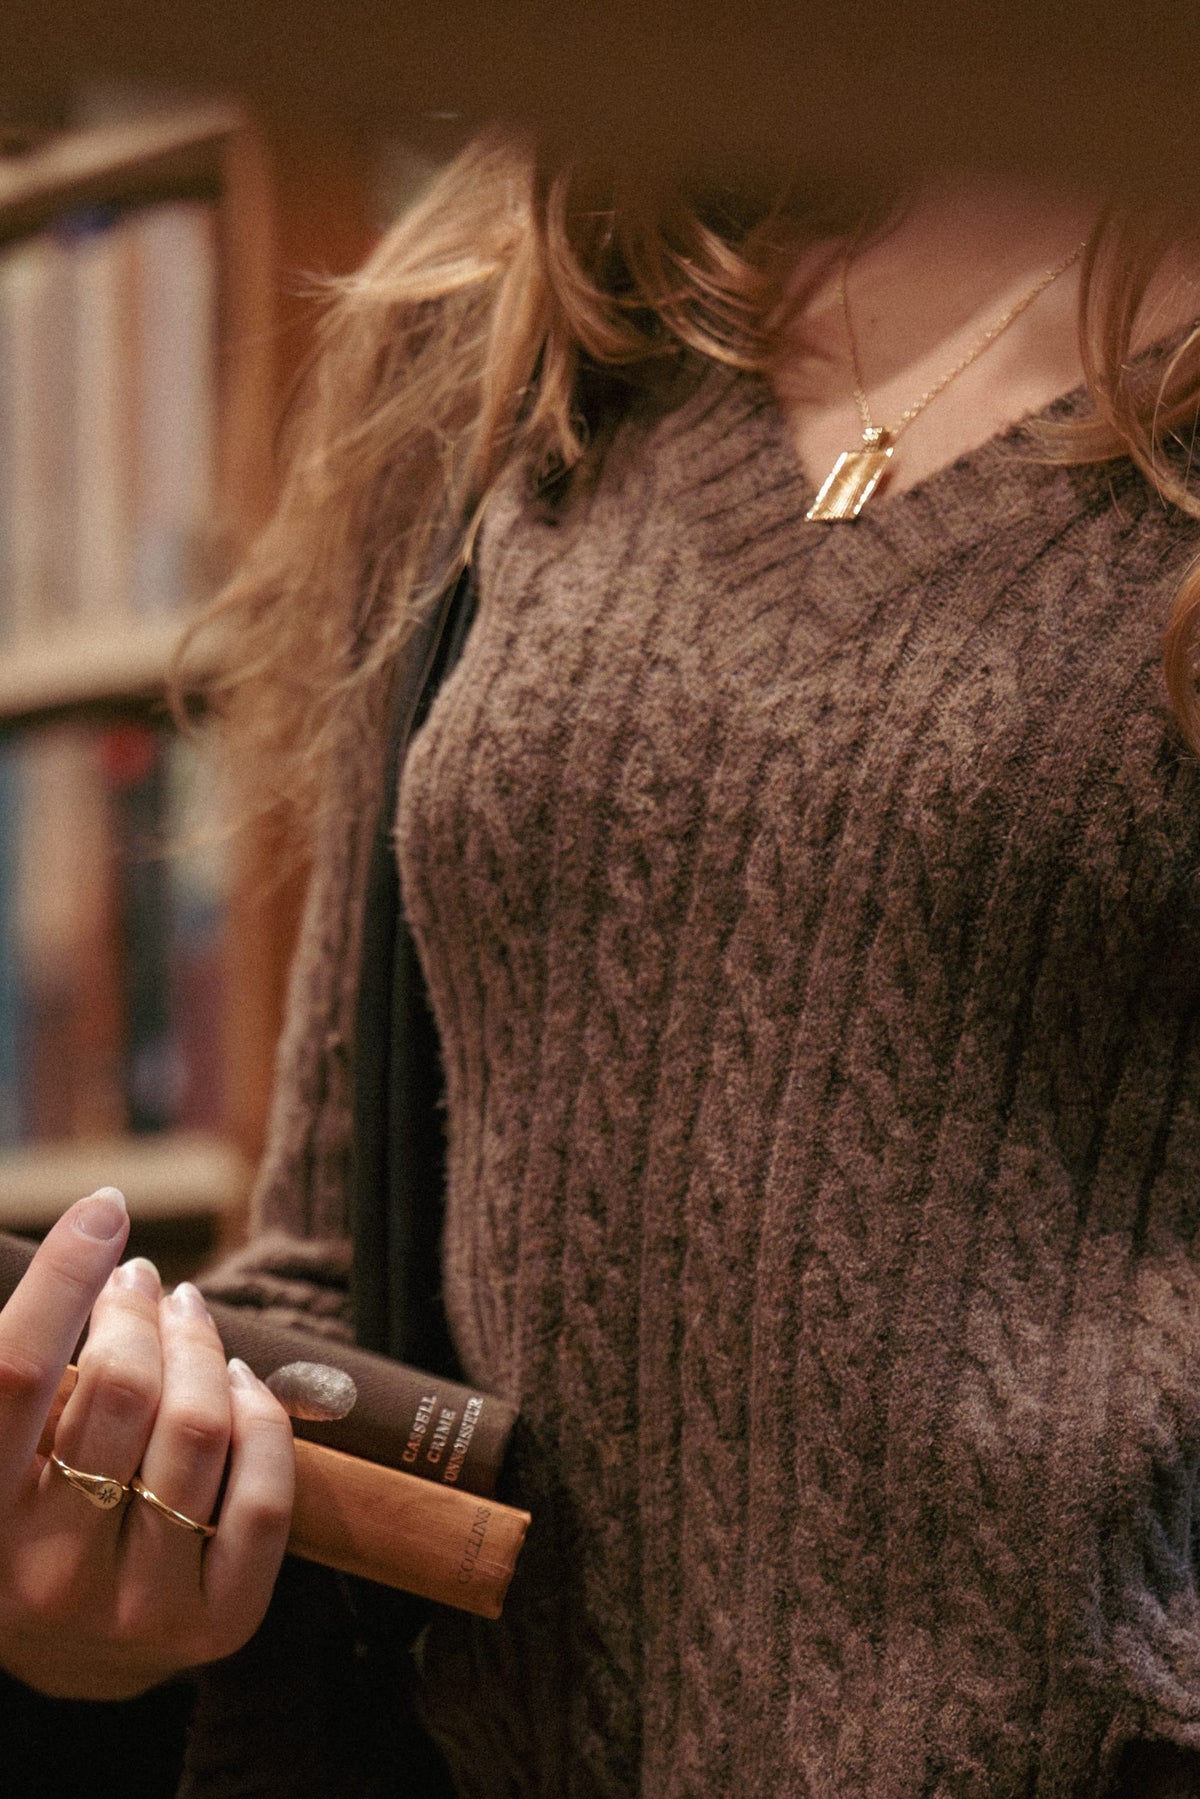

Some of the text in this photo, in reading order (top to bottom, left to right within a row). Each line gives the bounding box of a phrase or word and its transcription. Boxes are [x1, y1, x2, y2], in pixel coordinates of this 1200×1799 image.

[403, 1395, 437, 1463] CASSELL
[427, 1408, 456, 1464] CRIME
[443, 1396, 484, 1483] ONNOISSEUR
[458, 1506, 492, 1585] COLLINS
